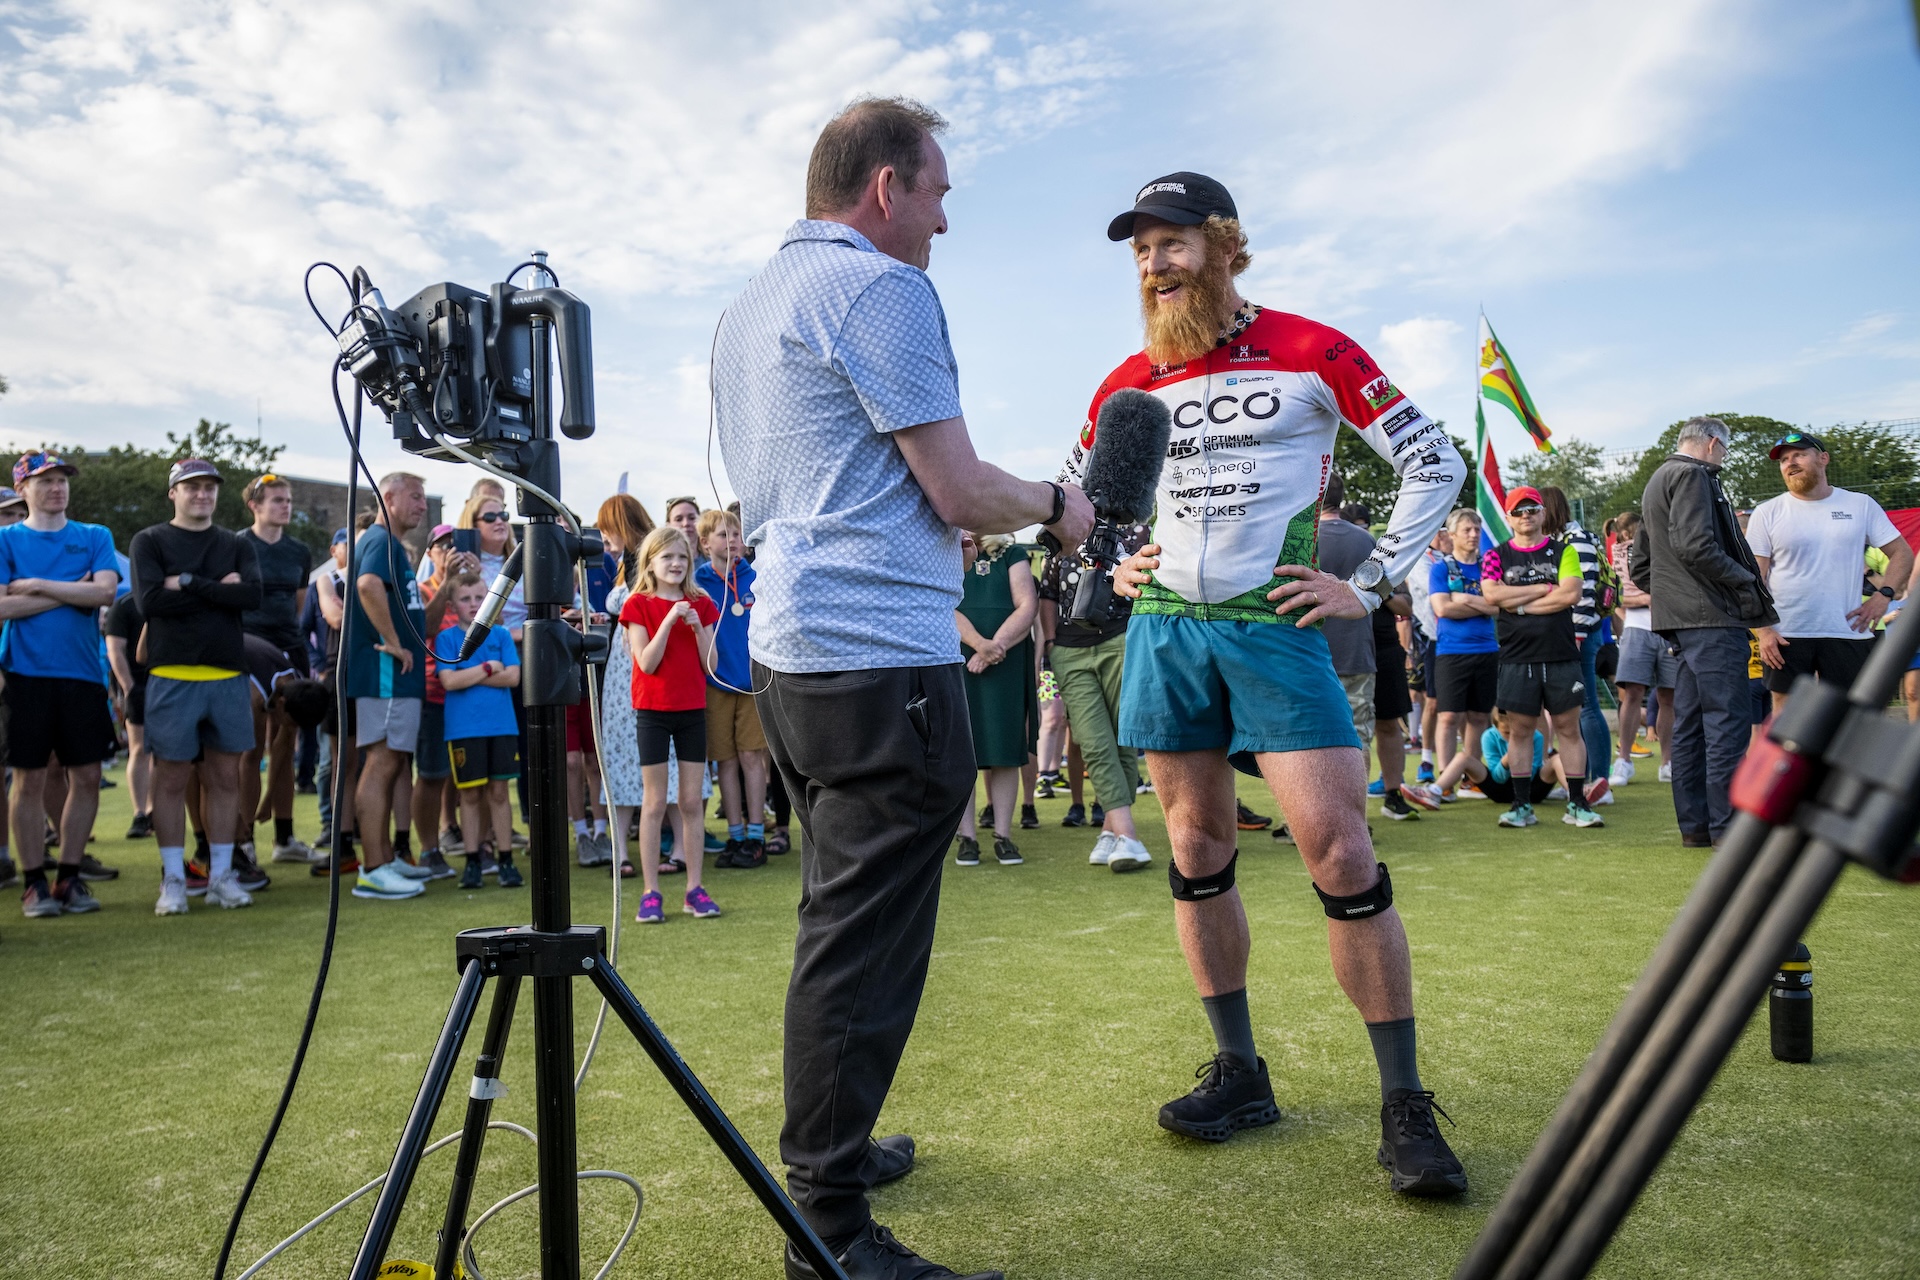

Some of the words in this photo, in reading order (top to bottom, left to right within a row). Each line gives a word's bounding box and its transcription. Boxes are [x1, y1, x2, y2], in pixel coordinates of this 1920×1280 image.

[512, 295, 544, 305] NANLITE
[1218, 313, 1255, 339] ecco
[1325, 339, 1357, 361] ecc
[1152, 369, 1187, 381] FOUNDATION
[1173, 391, 1281, 429] cco
[1384, 415, 1400, 429] TOTAL
[1386, 416, 1410, 434] TRAINING
[1203, 434, 1253, 444] OPTIMUM
[1204, 441, 1261, 452] NUTRITION
[1392, 424, 1436, 457] ZIPP
[1417, 436, 1449, 454] GIRO
[1186, 459, 1256, 478] myenergi
[1169, 484, 1237, 500] TWISTED
[1192, 505, 1246, 518] SPOKES
[387, 1264, 419, 1277] Way
